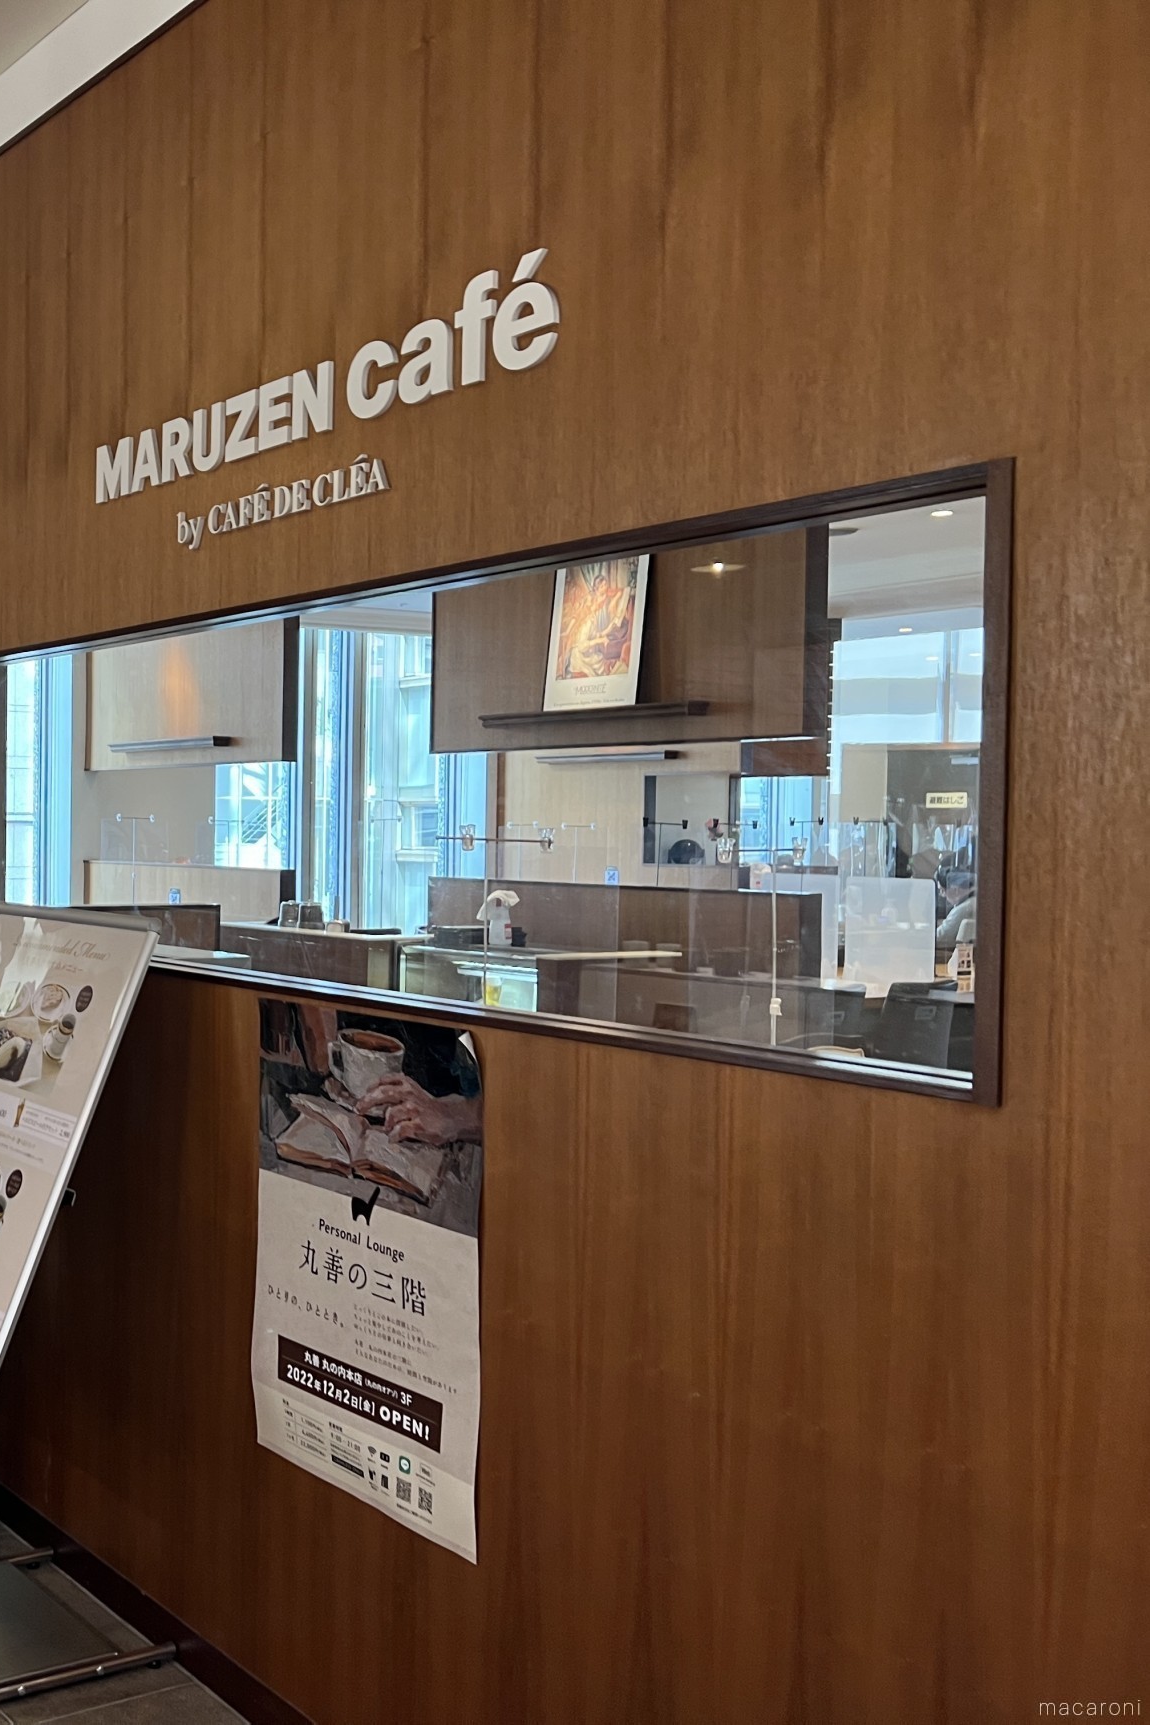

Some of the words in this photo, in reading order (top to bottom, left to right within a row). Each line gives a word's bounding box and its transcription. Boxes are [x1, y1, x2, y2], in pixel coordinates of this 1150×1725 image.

[96, 361, 334, 504] MARUZEN
[177, 512, 204, 549] by
[208, 483, 271, 534] CAFÉ
[273, 479, 311, 518] DE
[312, 454, 390, 506] CLÉA
[319, 1218, 361, 1245] Personal
[366, 1235, 405, 1263] Lounge
[299, 1240, 426, 1316] 丸善の三階
[304, 1350, 320, 1369] 丸善
[322, 1358, 363, 1387] 丸の内本店
[400, 1391, 413, 1407] 3F
[379, 1405, 430, 1441] OPEN!
